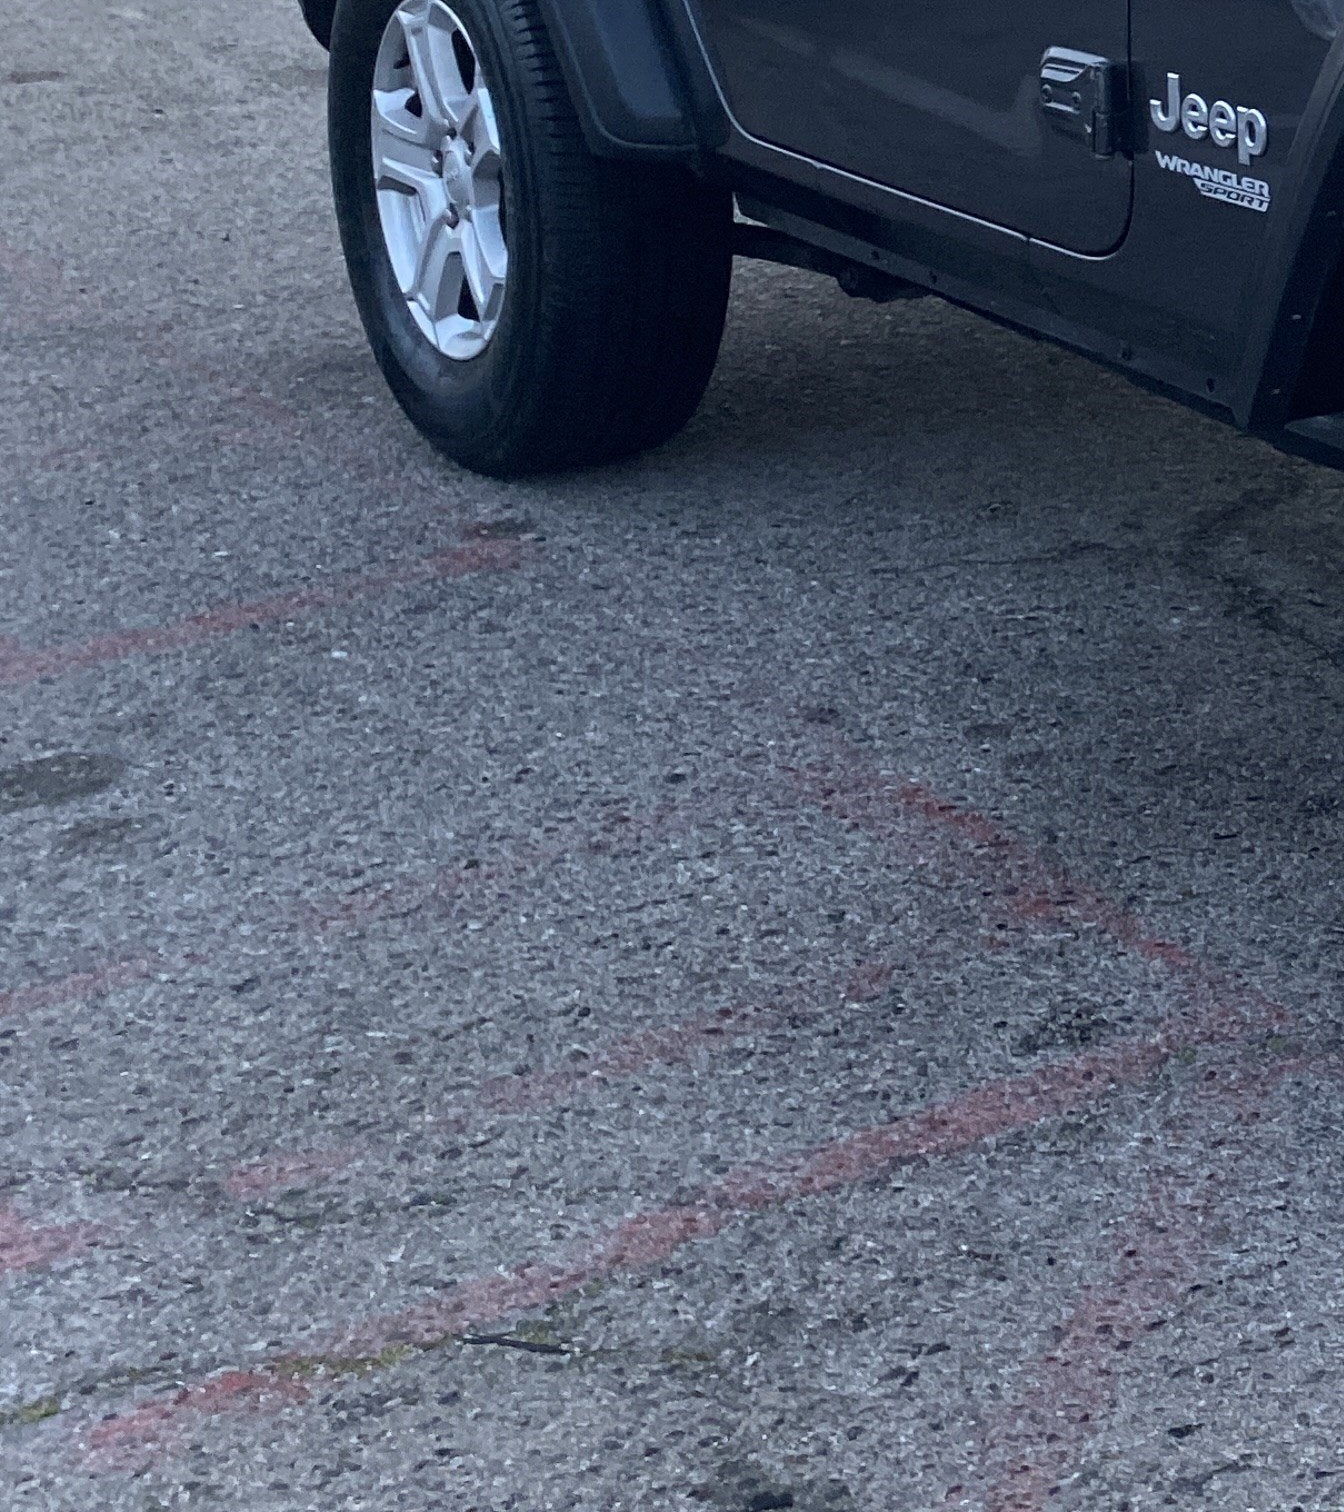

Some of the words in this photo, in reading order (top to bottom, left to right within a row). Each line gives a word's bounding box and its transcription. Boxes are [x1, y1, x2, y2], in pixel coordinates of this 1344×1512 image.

[1149, 71, 1268, 167] Jeep
[1154, 149, 1271, 198] WRANGLER
[1199, 182, 1270, 209] SPORT
